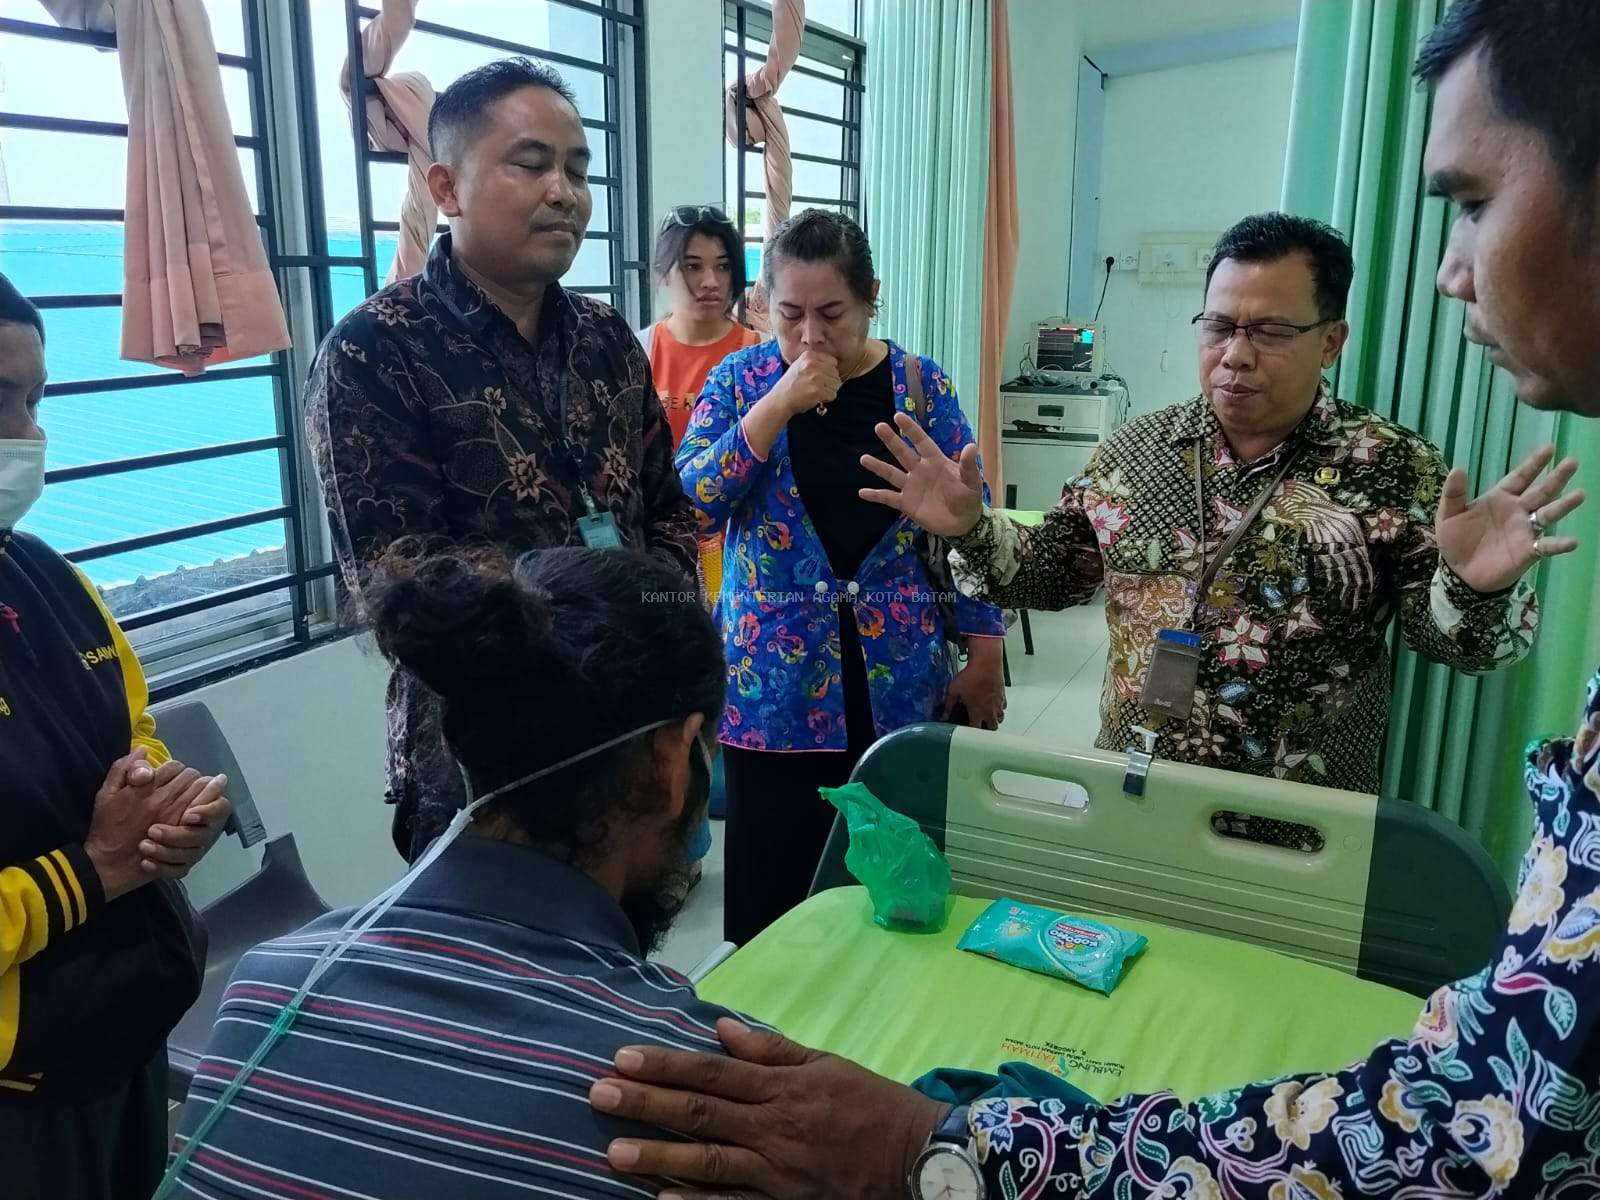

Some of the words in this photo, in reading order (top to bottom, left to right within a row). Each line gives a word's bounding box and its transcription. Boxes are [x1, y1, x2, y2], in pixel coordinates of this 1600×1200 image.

[1050, 930, 1098, 947] KODOMO
[1001, 1042, 1056, 1062] FATIMAH
[1068, 1060, 1122, 1077] EMBUNG
